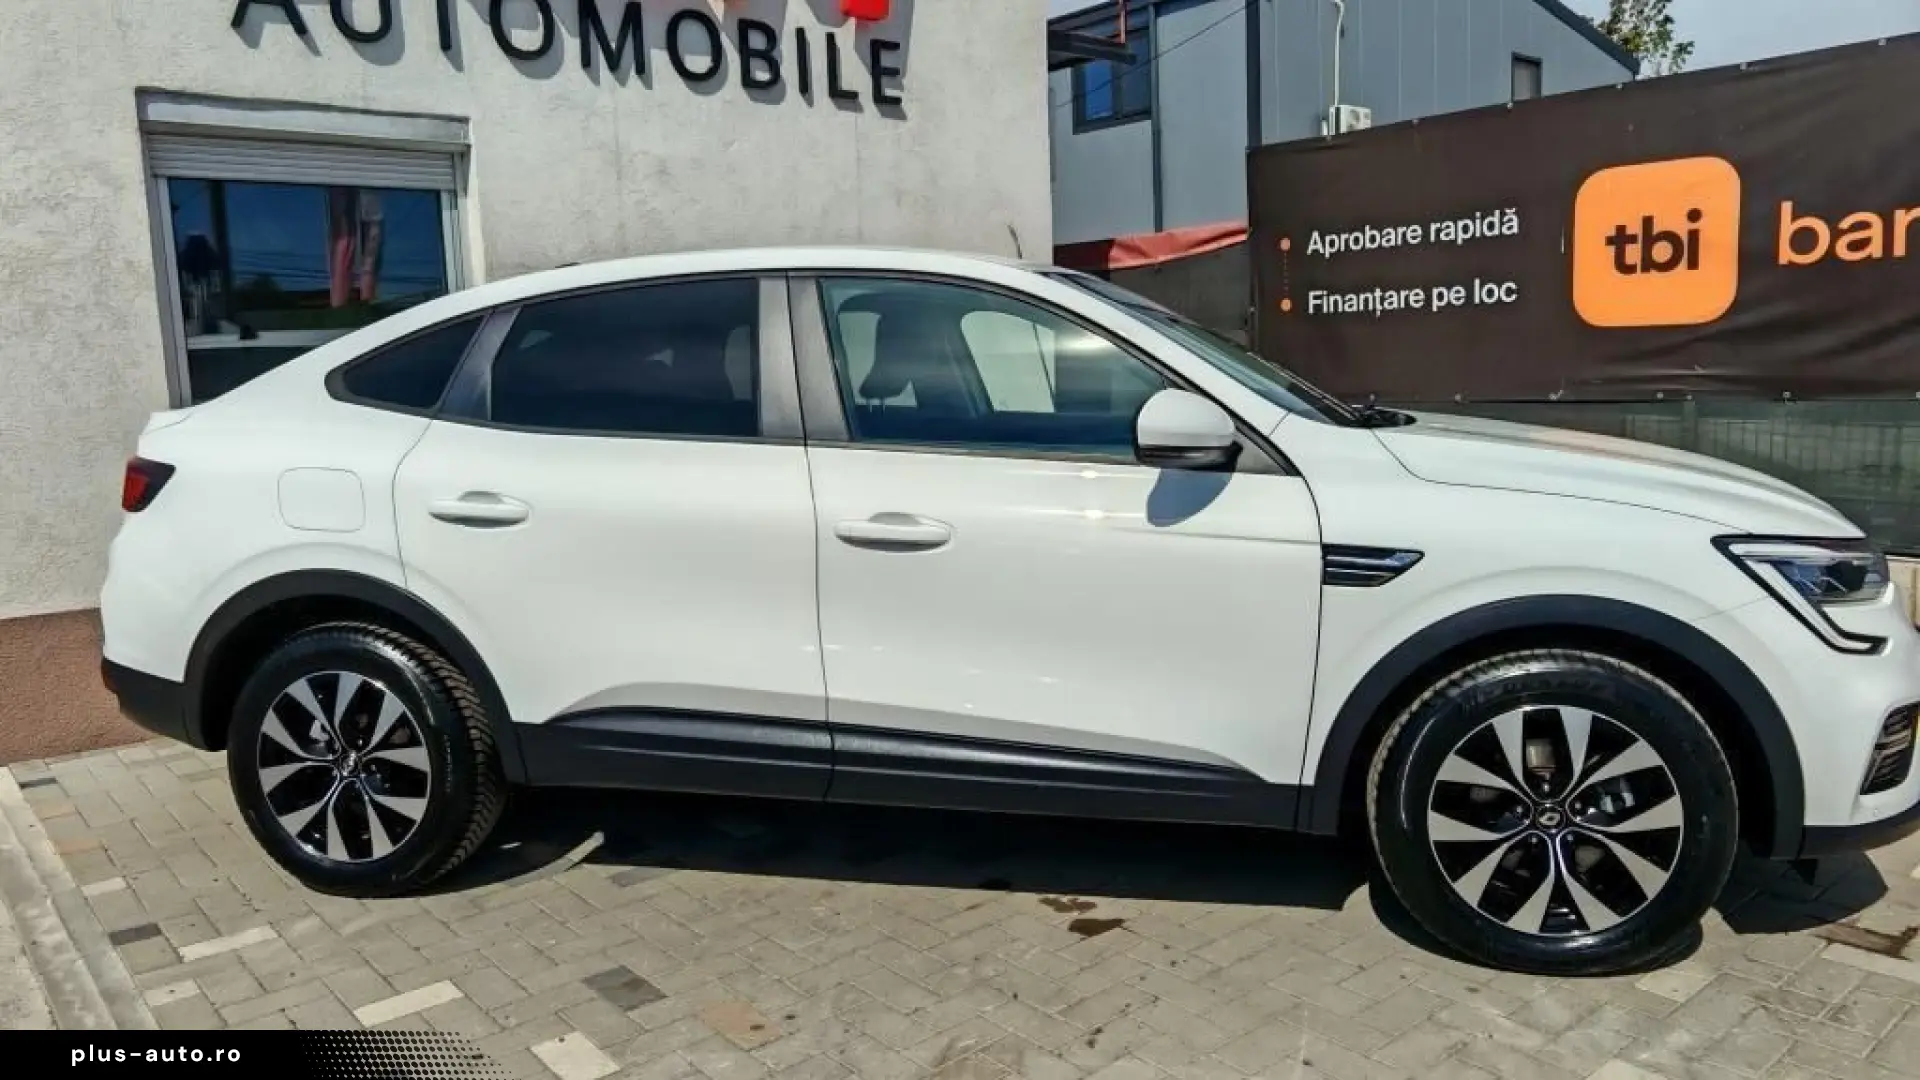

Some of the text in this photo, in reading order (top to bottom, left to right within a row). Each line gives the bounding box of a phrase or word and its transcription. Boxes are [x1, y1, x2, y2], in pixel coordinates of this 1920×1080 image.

[1306, 207, 1519, 259] Aprobare rapidă
[1605, 207, 1703, 275] tbi
[1308, 278, 1518, 318] Finanțare pe loc
